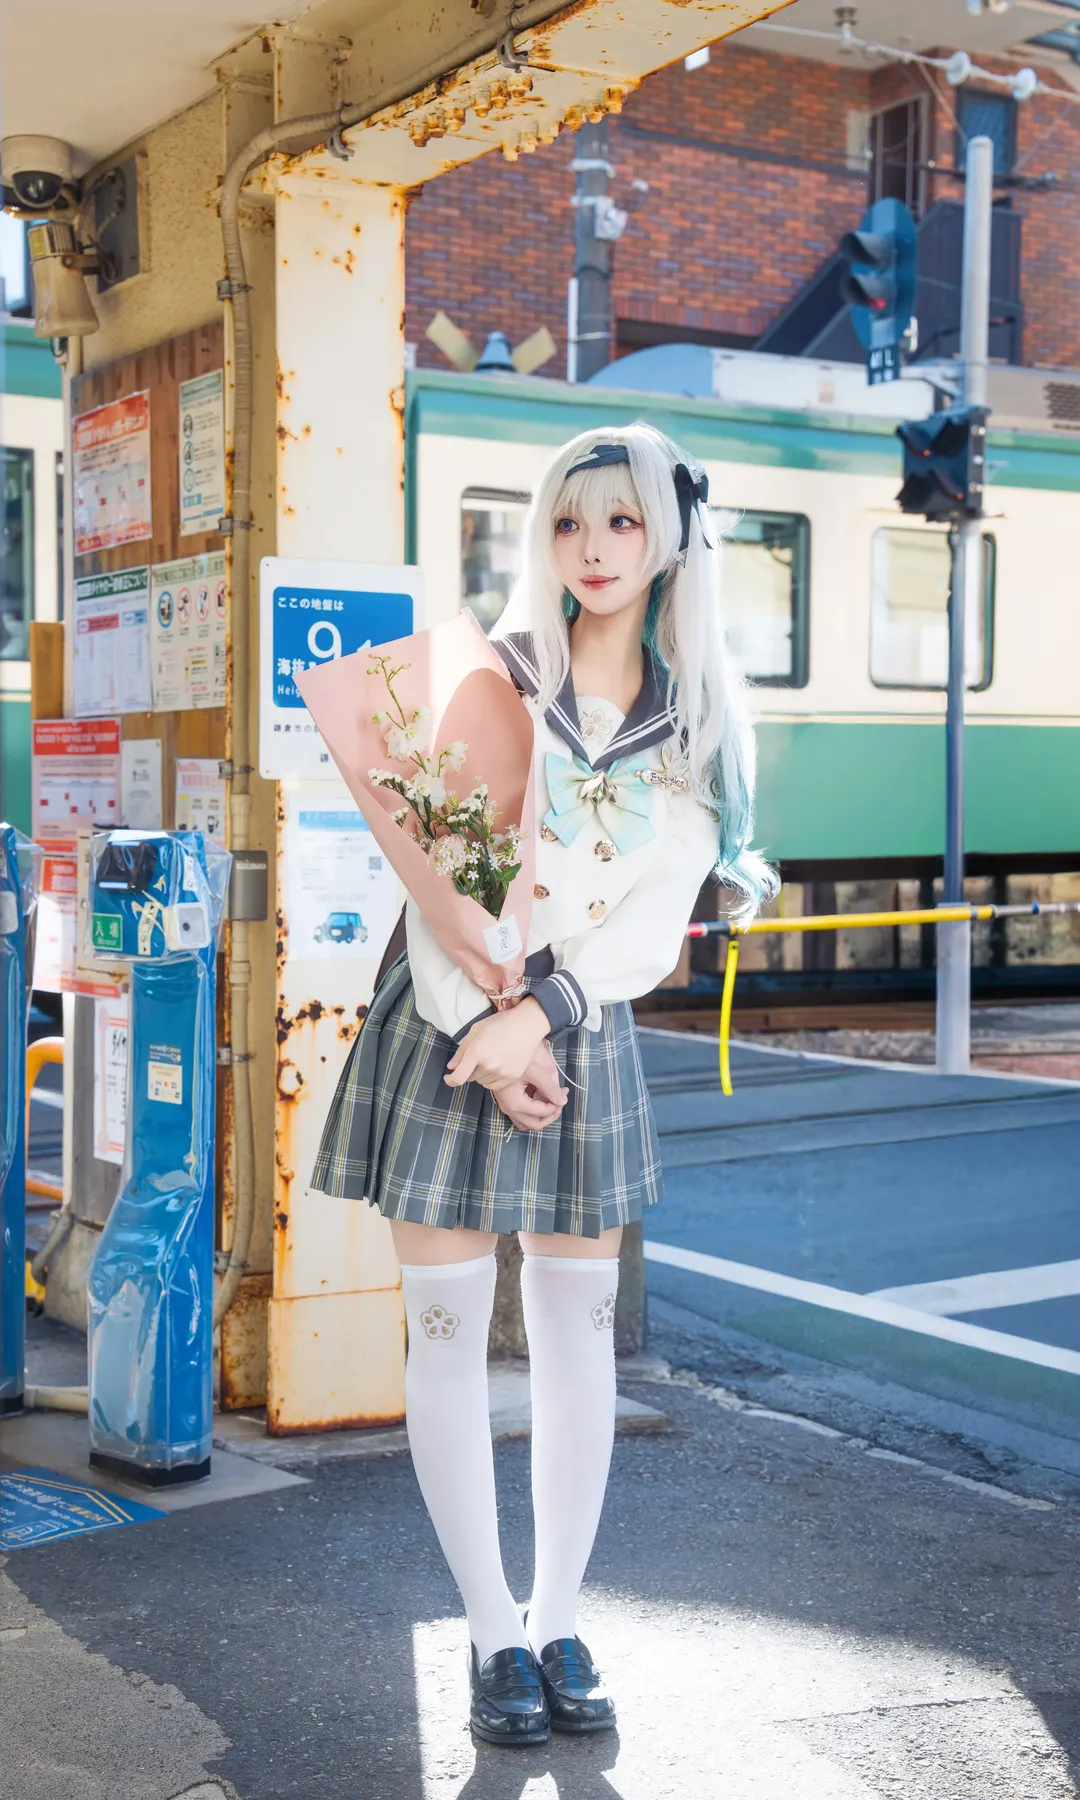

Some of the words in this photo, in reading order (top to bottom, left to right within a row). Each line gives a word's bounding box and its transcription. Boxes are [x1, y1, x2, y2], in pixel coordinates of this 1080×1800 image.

[278, 597, 344, 611] ここの地盤は
